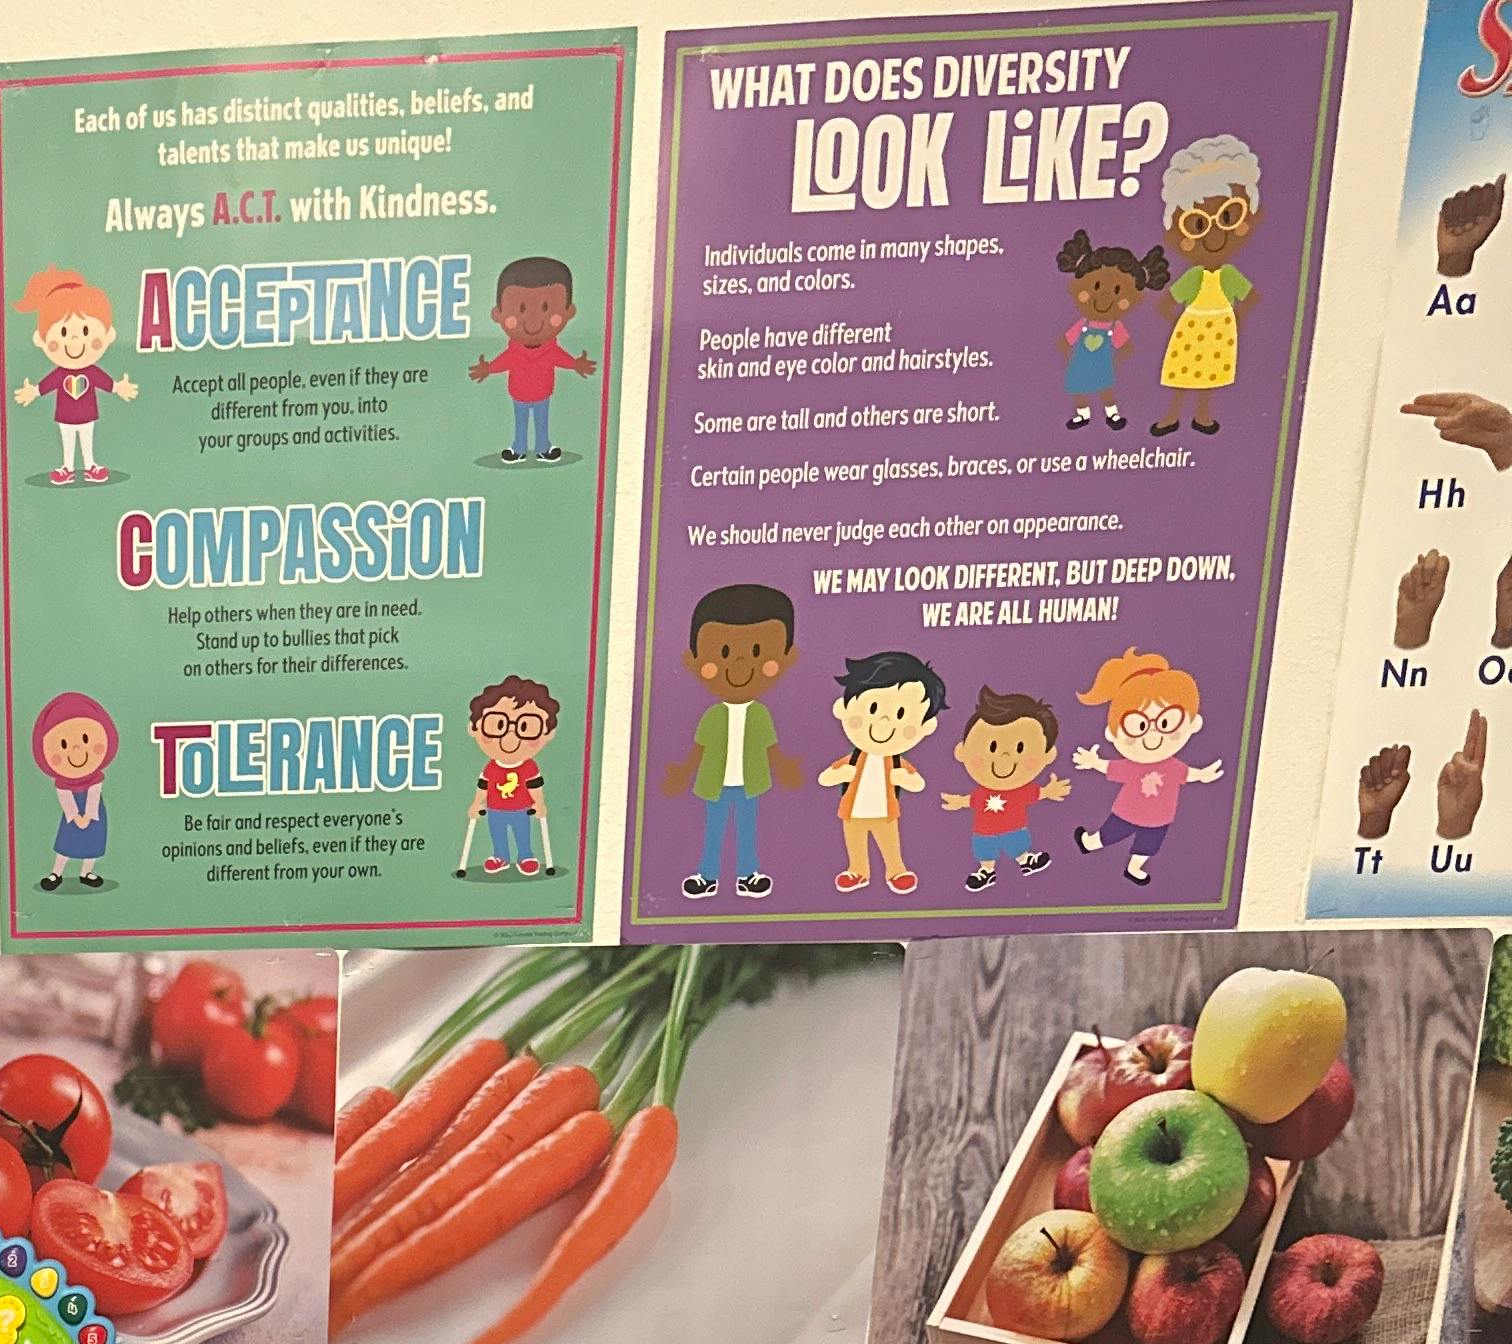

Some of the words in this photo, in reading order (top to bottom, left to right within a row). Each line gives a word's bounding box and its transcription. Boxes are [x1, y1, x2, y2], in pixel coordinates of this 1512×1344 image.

[711, 63, 816, 109] WHAT
[823, 57, 924, 104] DOES
[933, 46, 1131, 98] DIVERSITY
[158, 139, 231, 166] talents
[236, 136, 280, 161] that
[285, 133, 340, 159] make
[346, 138, 369, 156] us
[375, 127, 452, 160] unique!
[791, 111, 954, 213] LOOK
[106, 198, 205, 237] Always
[213, 190, 281, 225] A.C.T.
[290, 187, 351, 222] with
[360, 184, 496, 219] Kindness.
[137, 254, 471, 352] ACCEPTANCE
[1426, 283, 1477, 316] Aa
[700, 327, 760, 355] People
[764, 326, 808, 348] have
[812, 322, 892, 346] different
[695, 412, 743, 434] Some
[747, 415, 777, 432] are
[781, 408, 810, 430] tall
[814, 406, 848, 428] and
[851, 405, 909, 427] others
[913, 408, 943, 424] are
[947, 401, 1000, 423] short.
[1418, 478, 1465, 508] Hh
[923, 602, 952, 627] WE
[955, 601, 994, 626] ARE
[997, 600, 1033, 624] ALL
[1038, 596, 1119, 623] HUMAN!
[1381, 659, 1428, 688] Nn
[1478, 655, 1512, 685] O
[151, 714, 443, 798] TOLERANCE
[1354, 847, 1383, 874] Tt
[1431, 845, 1473, 873] Uu
[7, 1253, 18, 1268] 2
[67, 1301, 78, 1316] 4
